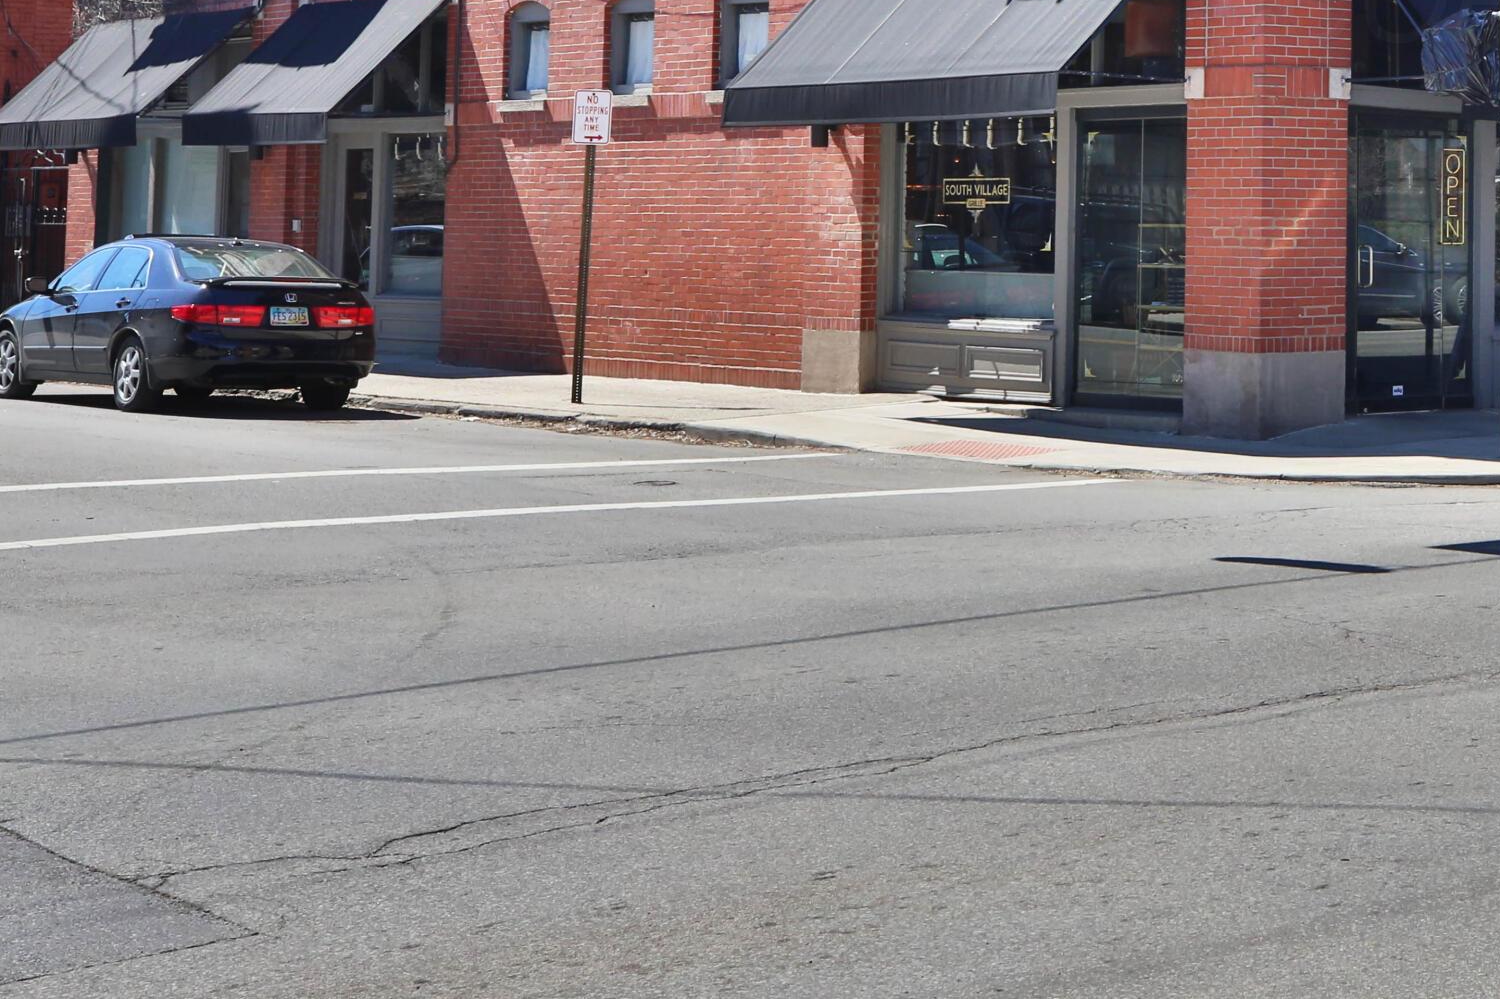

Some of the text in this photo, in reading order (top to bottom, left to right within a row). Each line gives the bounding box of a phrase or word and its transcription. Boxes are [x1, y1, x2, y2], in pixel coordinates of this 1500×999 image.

[587, 96, 598, 104] NO
[578, 106, 608, 115] STOPPING
[946, 184, 1008, 195] SOUTH VILLAGE
[1446, 154, 1460, 238] OPEN
